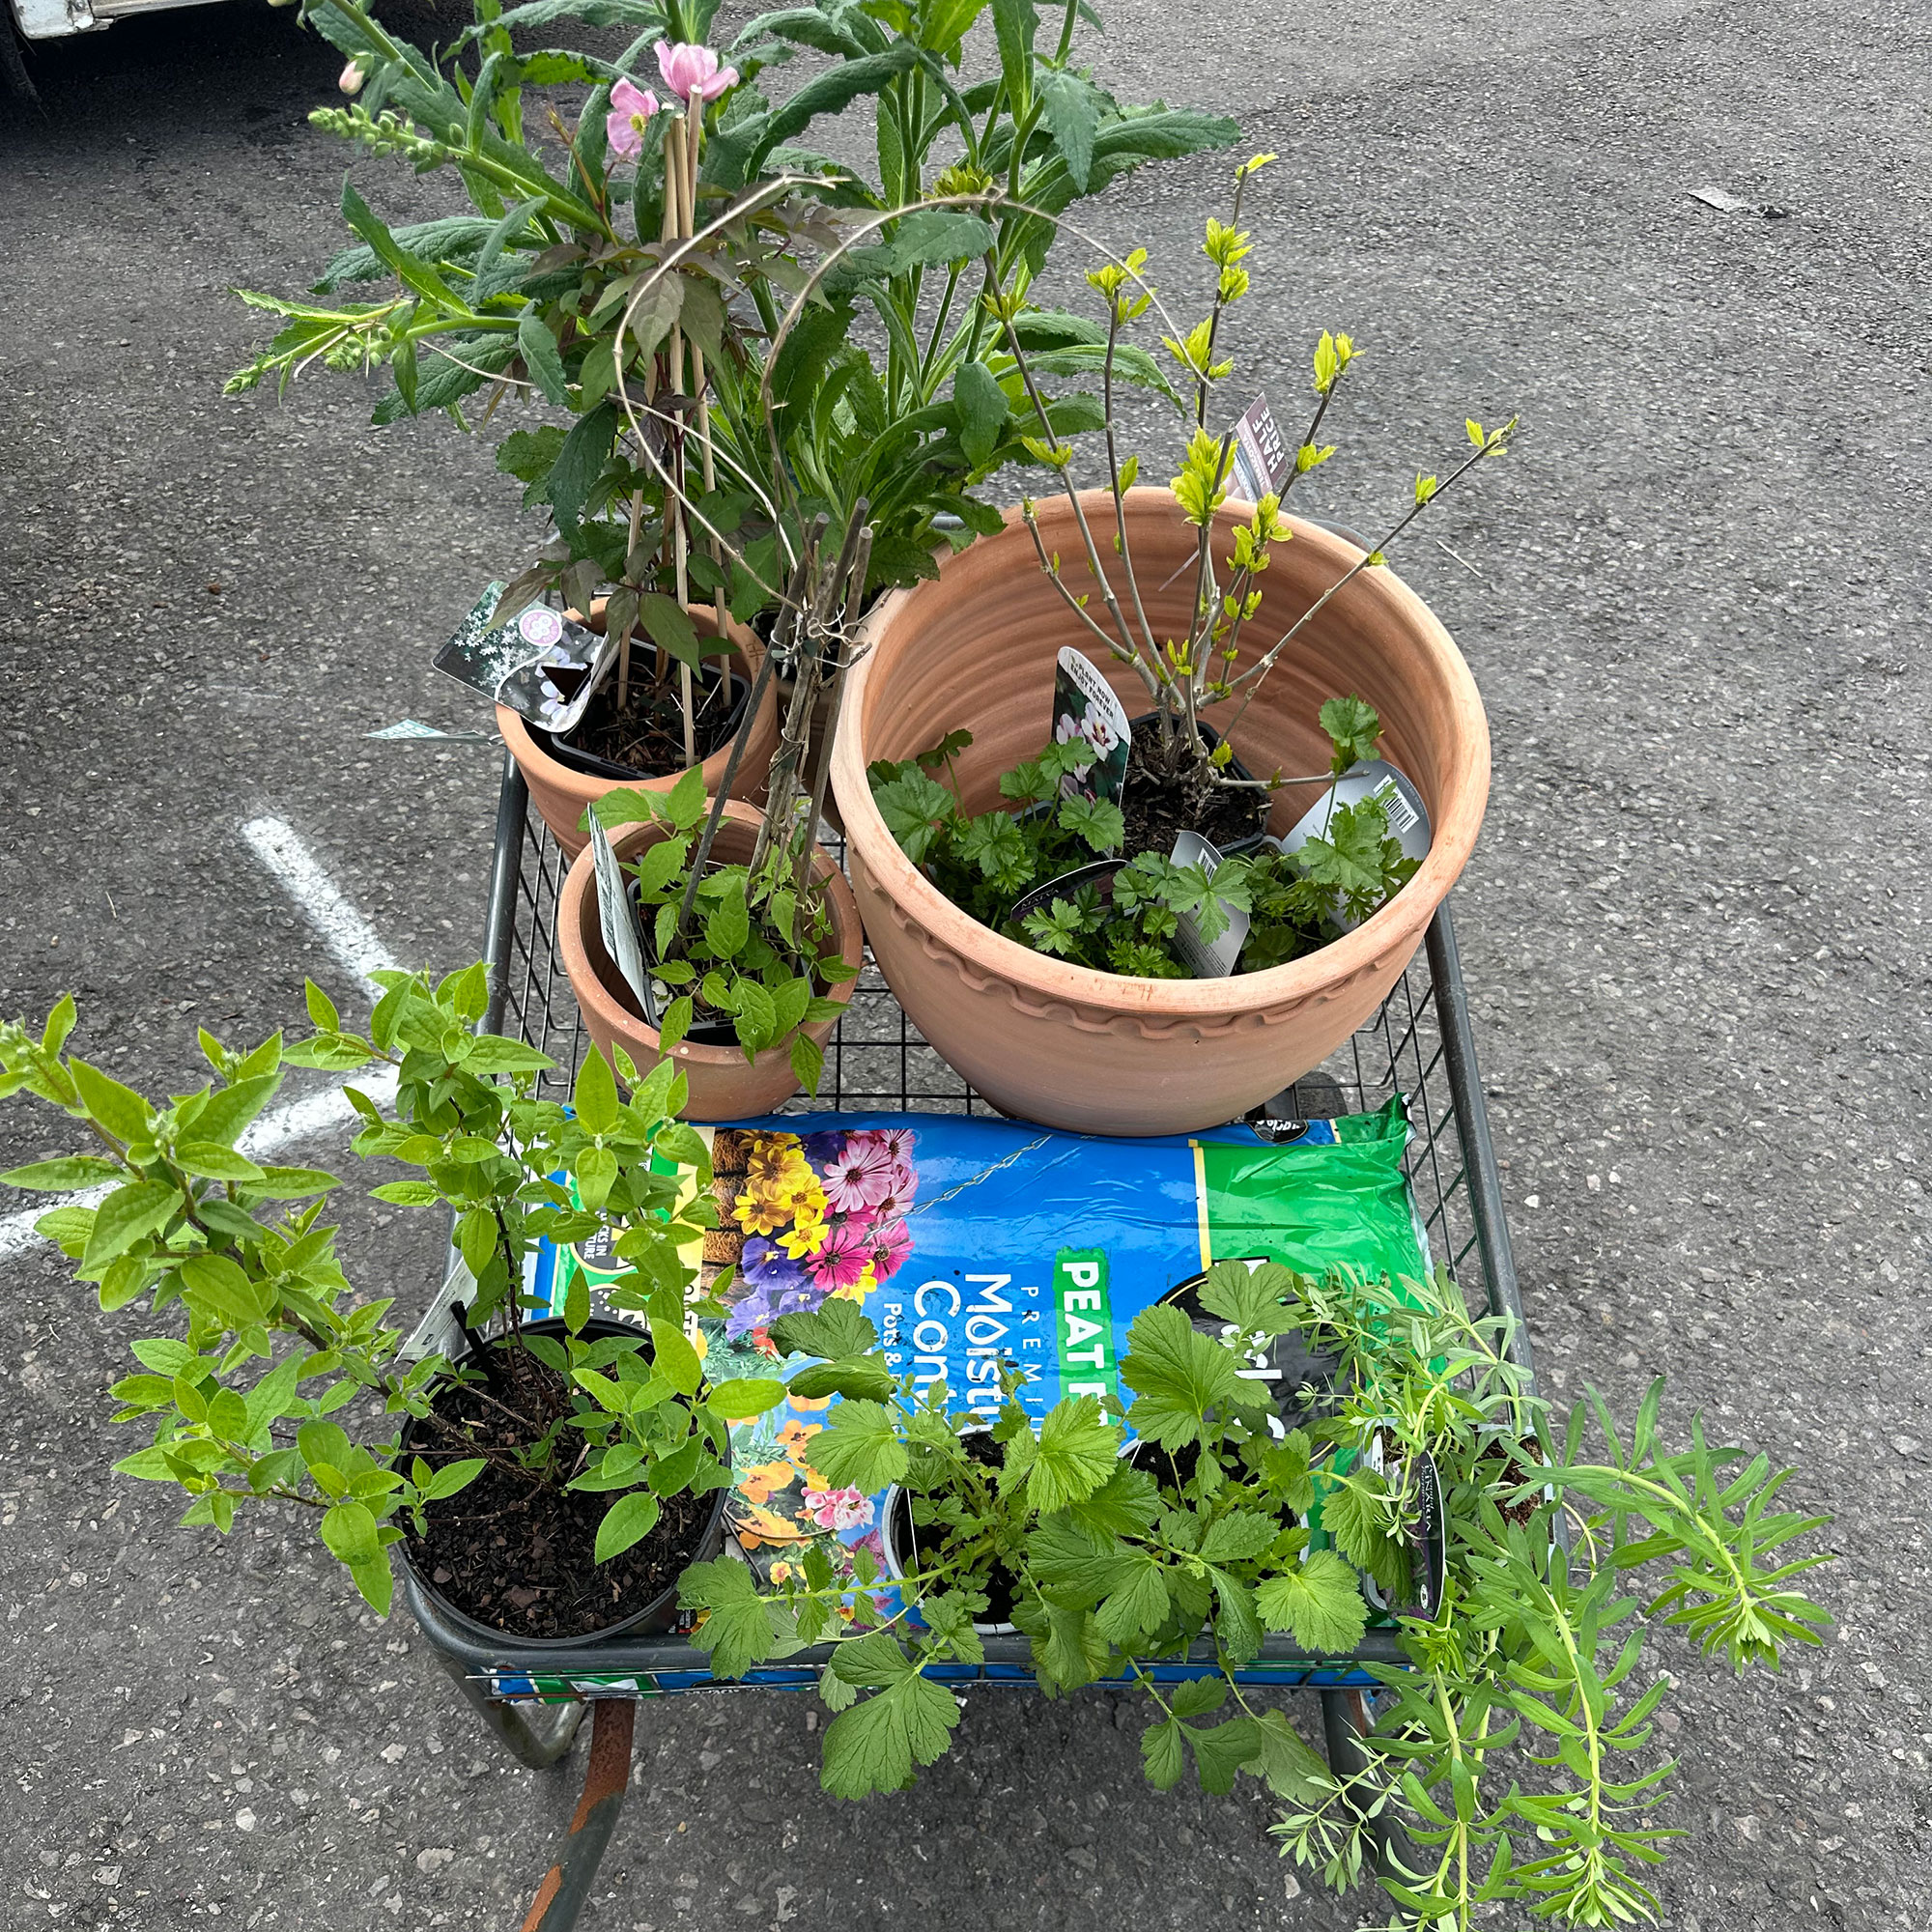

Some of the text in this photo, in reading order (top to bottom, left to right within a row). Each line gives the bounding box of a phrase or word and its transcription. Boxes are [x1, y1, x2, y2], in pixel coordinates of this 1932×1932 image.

[1252, 419, 1278, 474] HALF
[1261, 407, 1285, 463] PRICE
[1070, 663, 1114, 717] ENJOY FOREVER
[1078, 663, 1111, 704] PLANT NOW
[595, 1245, 608, 1257] IN
[883, 1303, 903, 1347] Pots
[1062, 1262, 1105, 1369] PEAT
[883, 1352, 903, 1367] &
[913, 1280, 961, 1420] Cont
[965, 1273, 1013, 1417] Moist
[1020, 1286, 1045, 1434] PREMIU
